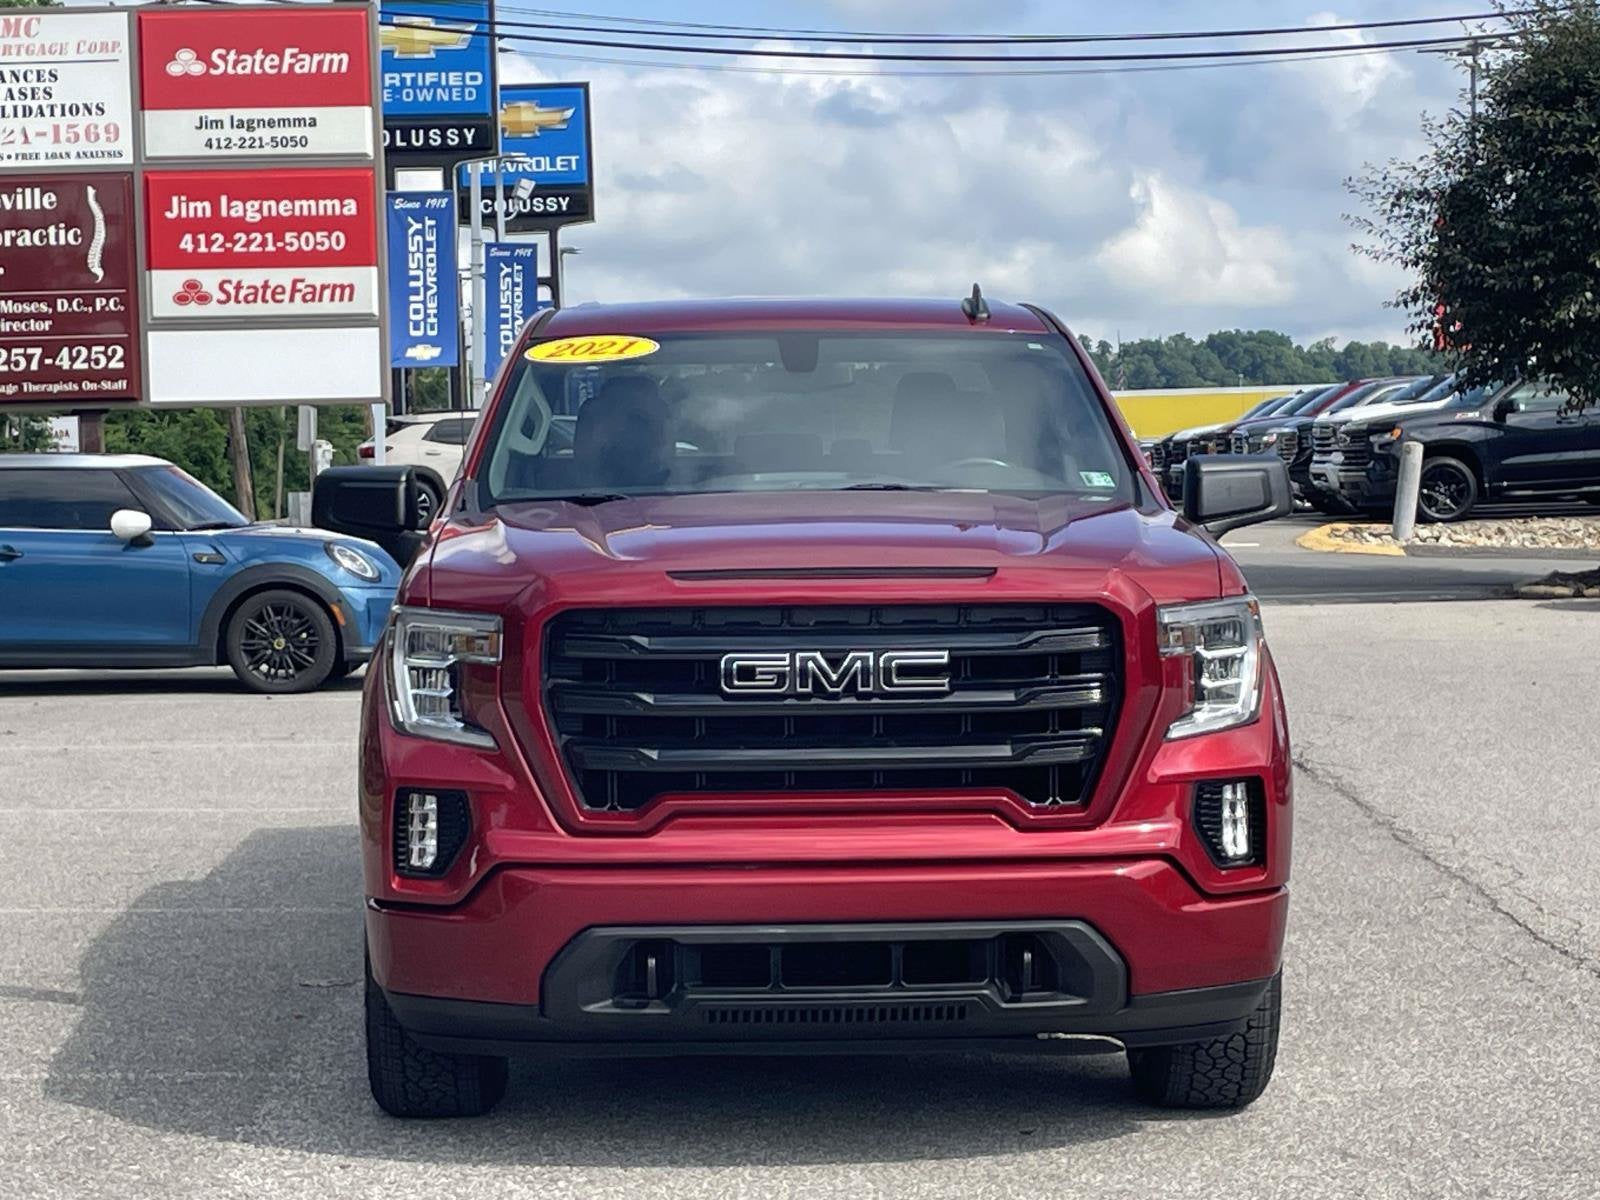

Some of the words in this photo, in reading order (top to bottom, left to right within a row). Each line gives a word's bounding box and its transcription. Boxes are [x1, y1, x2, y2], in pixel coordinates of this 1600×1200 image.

[383, 87, 477, 102] E-OWNED
[195, 115, 224, 131] Jim
[230, 115, 317, 132] Iagnemma
[204, 135, 308, 150] 412-221-5050
[0, 187, 57, 211] ville
[165, 196, 212, 220] Jim
[220, 195, 358, 223] Iagnemma
[394, 197, 421, 210] Since
[425, 197, 448, 209] 1918
[0, 222, 82, 247] ractic
[178, 231, 346, 254] 412-221-5050
[407, 216, 424, 337] COLUSSY
[424, 216, 438, 337] CHEVROLET
[95, 297, 125, 312] P.C.
[545, 340, 638, 358] 2021
[22, 381, 79, 394] Therapists
[82, 379, 127, 391] On-Staff
[720, 650, 950, 694] GMC
